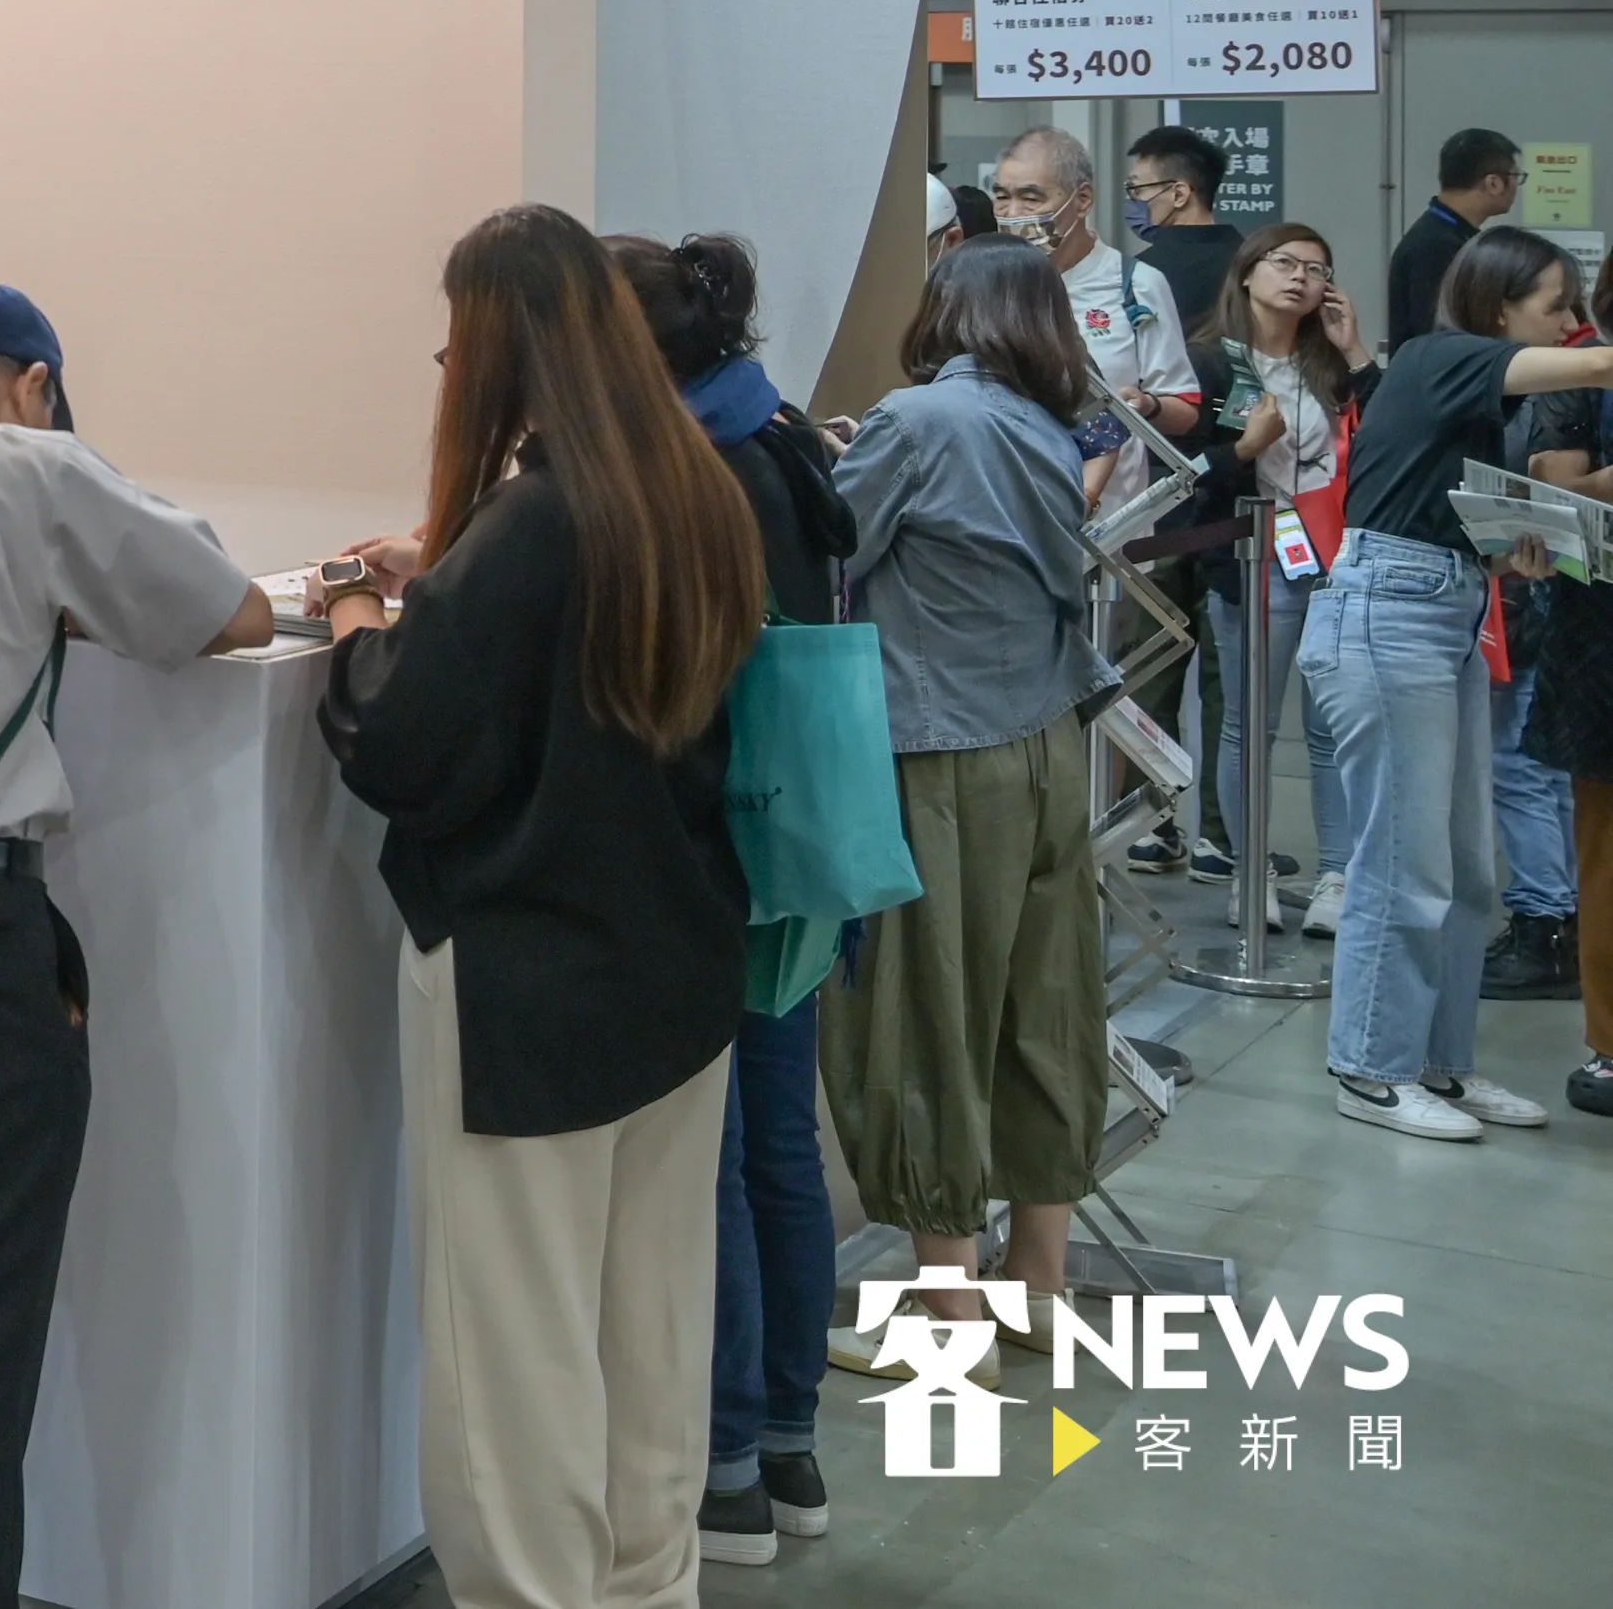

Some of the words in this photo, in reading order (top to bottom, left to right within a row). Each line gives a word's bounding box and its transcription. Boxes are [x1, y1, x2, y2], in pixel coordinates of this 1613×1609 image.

[1027, 48, 1152, 84] $3,400
[1221, 40, 1353, 77] $2,080
[1251, 184, 1273, 195] BY
[1219, 199, 1275, 212] STAMP
